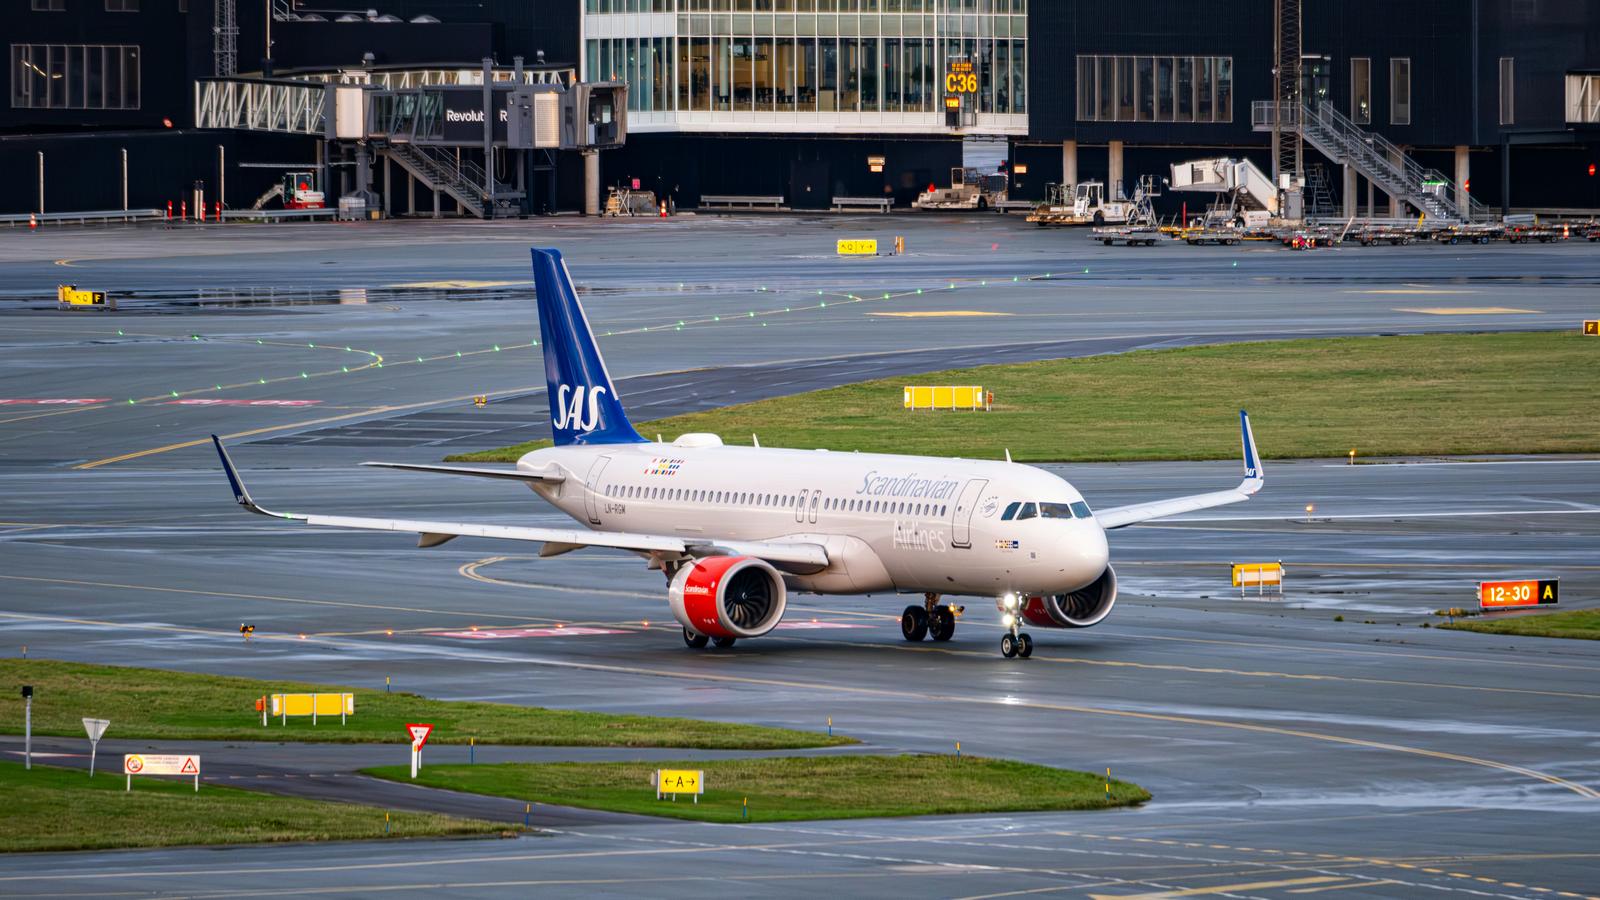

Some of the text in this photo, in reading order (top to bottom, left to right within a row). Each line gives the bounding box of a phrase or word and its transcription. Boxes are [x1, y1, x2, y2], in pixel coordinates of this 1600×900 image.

[946, 73, 977, 93] C36
[446, 109, 484, 122] Revolut
[94, 294, 101, 303] F
[1587, 323, 1594, 332] F
[553, 384, 606, 432] SAS
[856, 470, 959, 500] Scandinavian
[604, 503, 626, 515] LN-RGM
[893, 520, 946, 552] Airlines
[1490, 584, 1553, 602] 12-30 A
[676, 776, 684, 788] A
